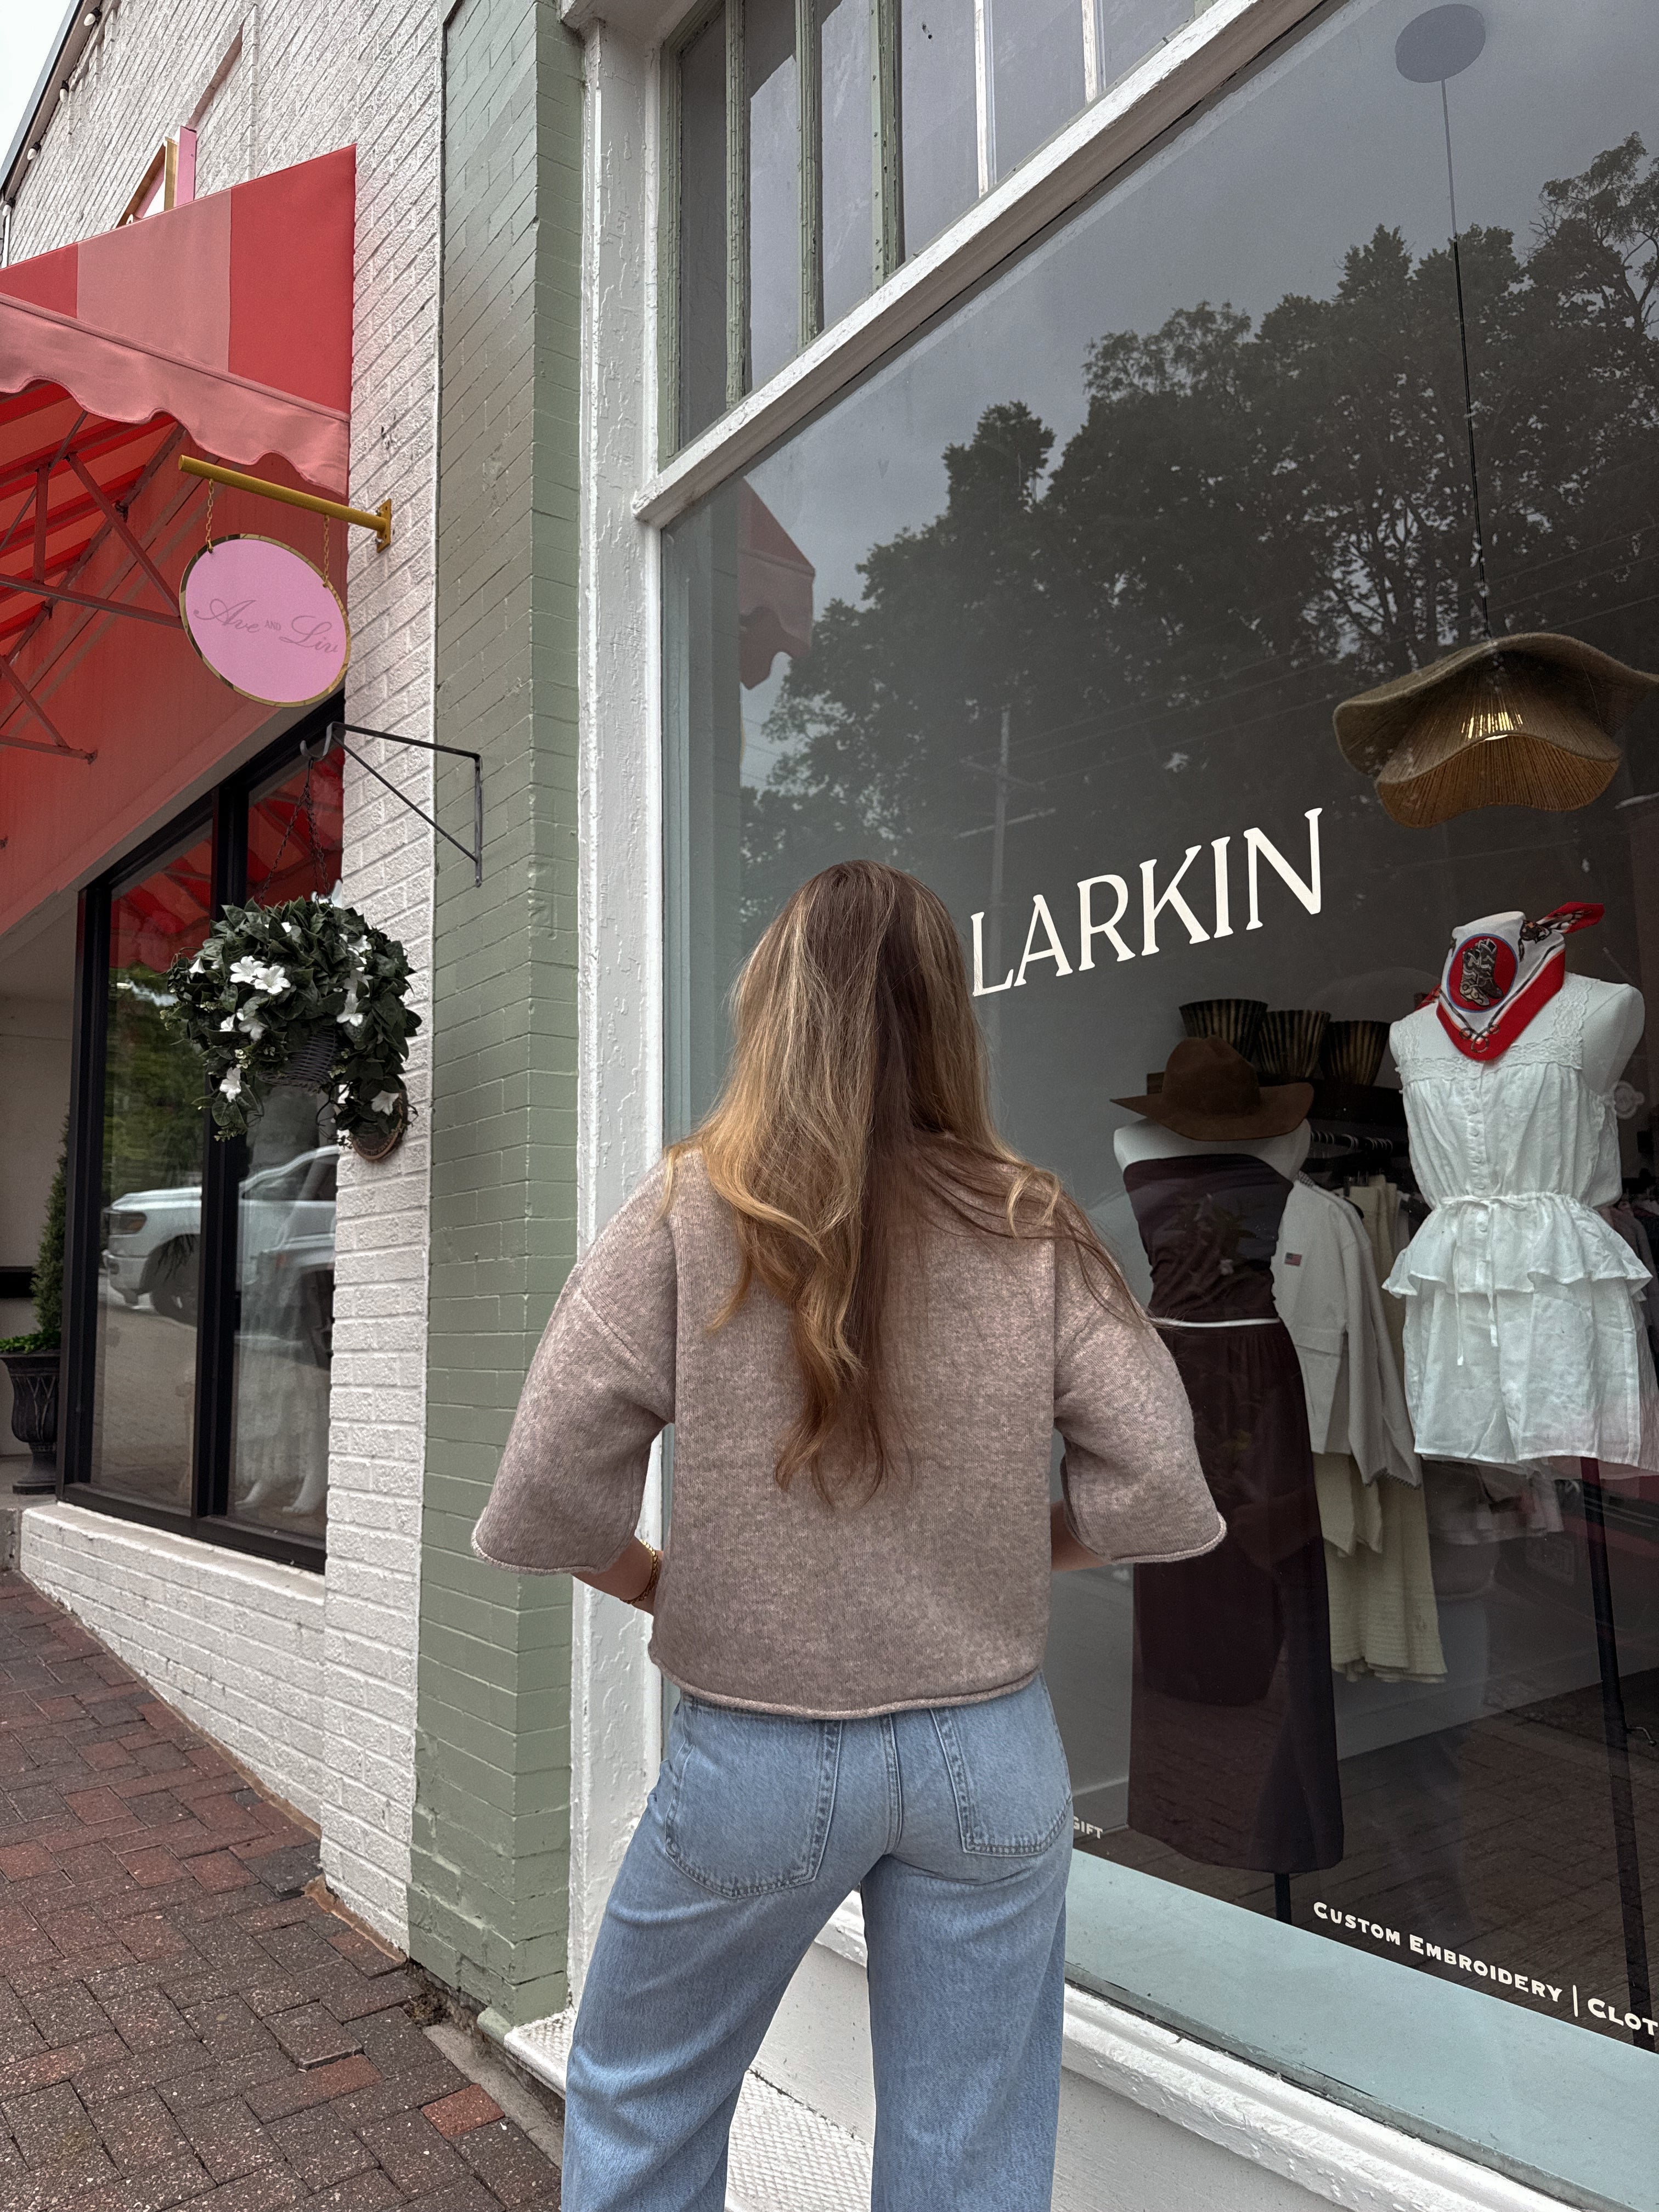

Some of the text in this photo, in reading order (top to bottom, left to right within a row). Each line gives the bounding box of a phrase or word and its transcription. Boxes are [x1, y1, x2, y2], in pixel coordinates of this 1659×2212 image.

[193, 599, 338, 652] Ave AND Liv
[970, 808, 1323, 997] LARKIN
[1313, 1901, 1658, 2036] CUSTOM EMBROIDERY CLOT
